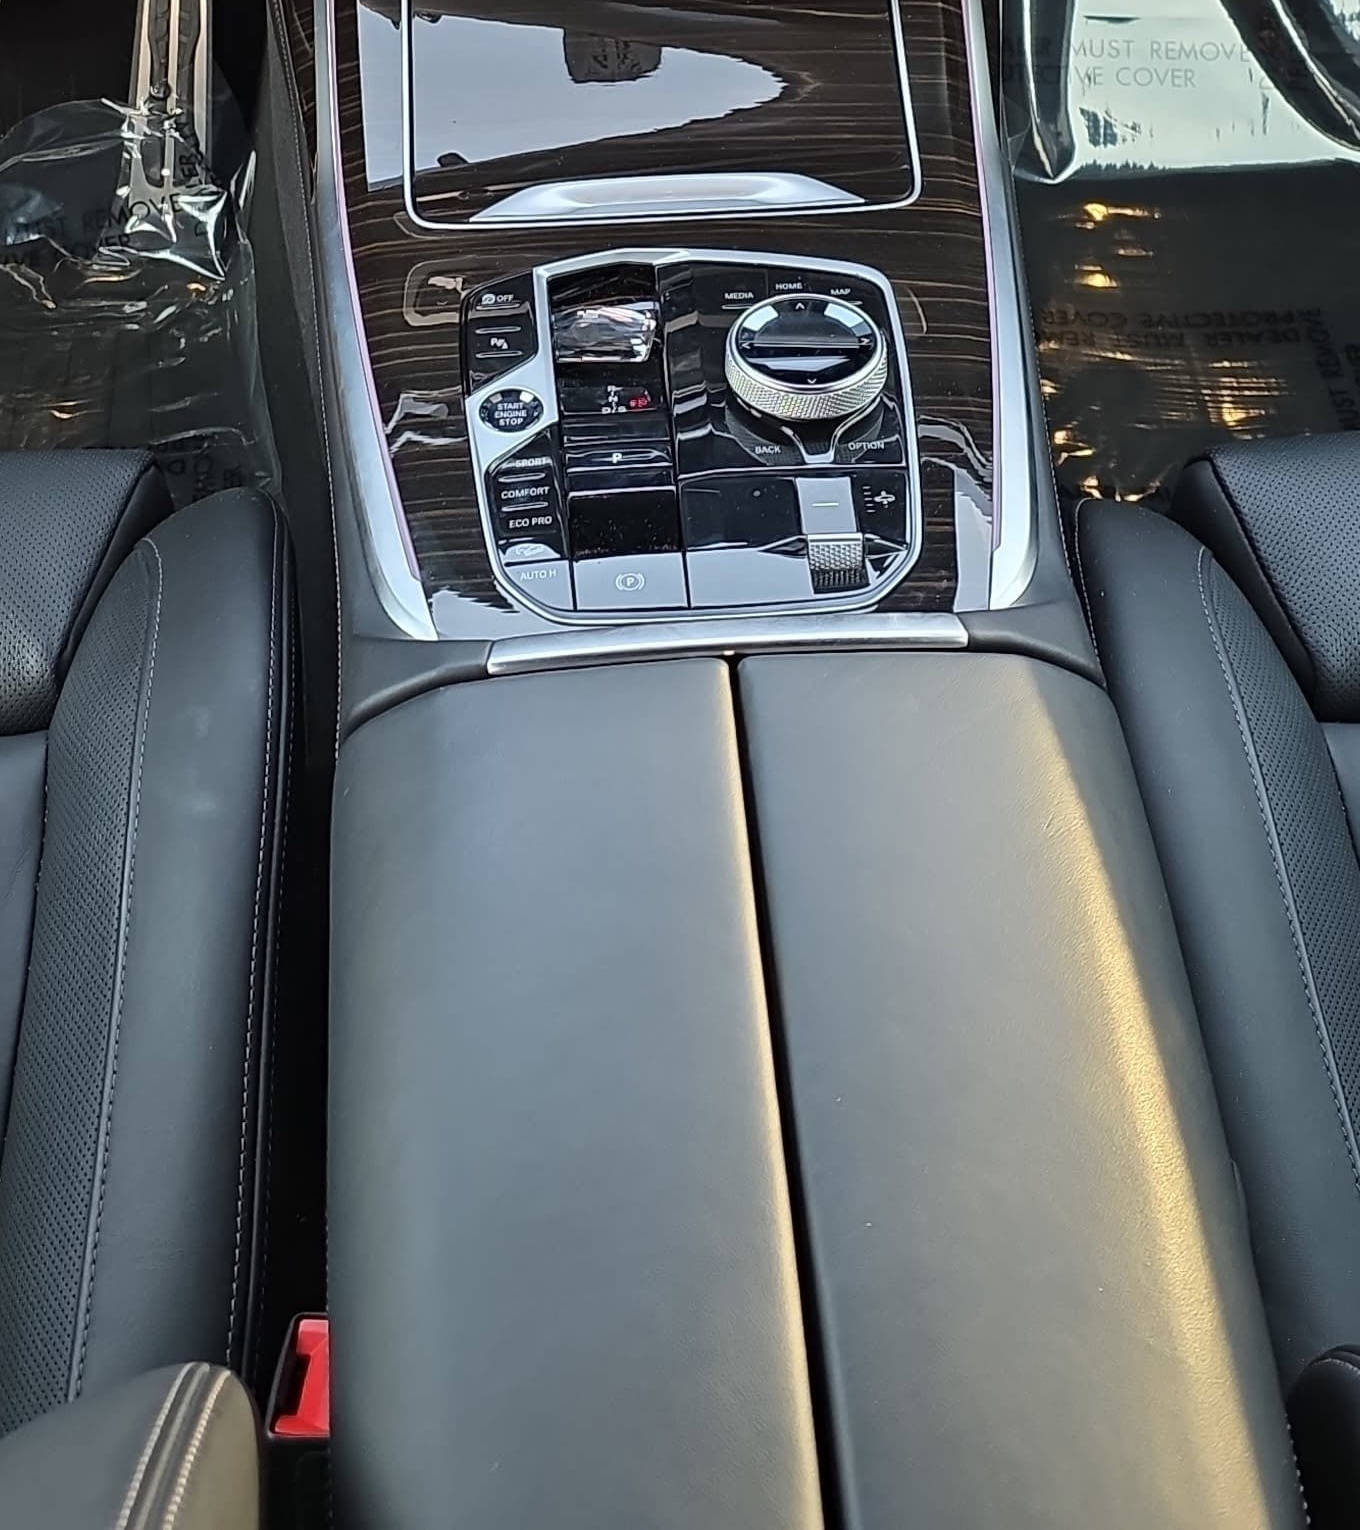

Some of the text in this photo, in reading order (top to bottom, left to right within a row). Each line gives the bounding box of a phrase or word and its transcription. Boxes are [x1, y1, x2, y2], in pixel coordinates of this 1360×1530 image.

[1071, 39, 1135, 60] MUST
[1150, 41, 1251, 64] REMOVE
[1116, 66, 1198, 88] COVER
[775, 282, 803, 290] HOME
[724, 291, 754, 300] MEDIA
[830, 287, 851, 296] MAP
[496, 294, 515, 303] OFF
[497, 402, 526, 411] START
[494, 409, 528, 419] ENGINE
[499, 417, 524, 427] STOP
[754, 446, 781, 455] BACK
[847, 441, 886, 452] OPTION
[515, 457, 548, 468] SPORT
[612, 452, 623, 464] P
[500, 486, 551, 500] COMFORT
[508, 515, 553, 529] ECO PRO
[519, 569, 558, 582] AUTO H
